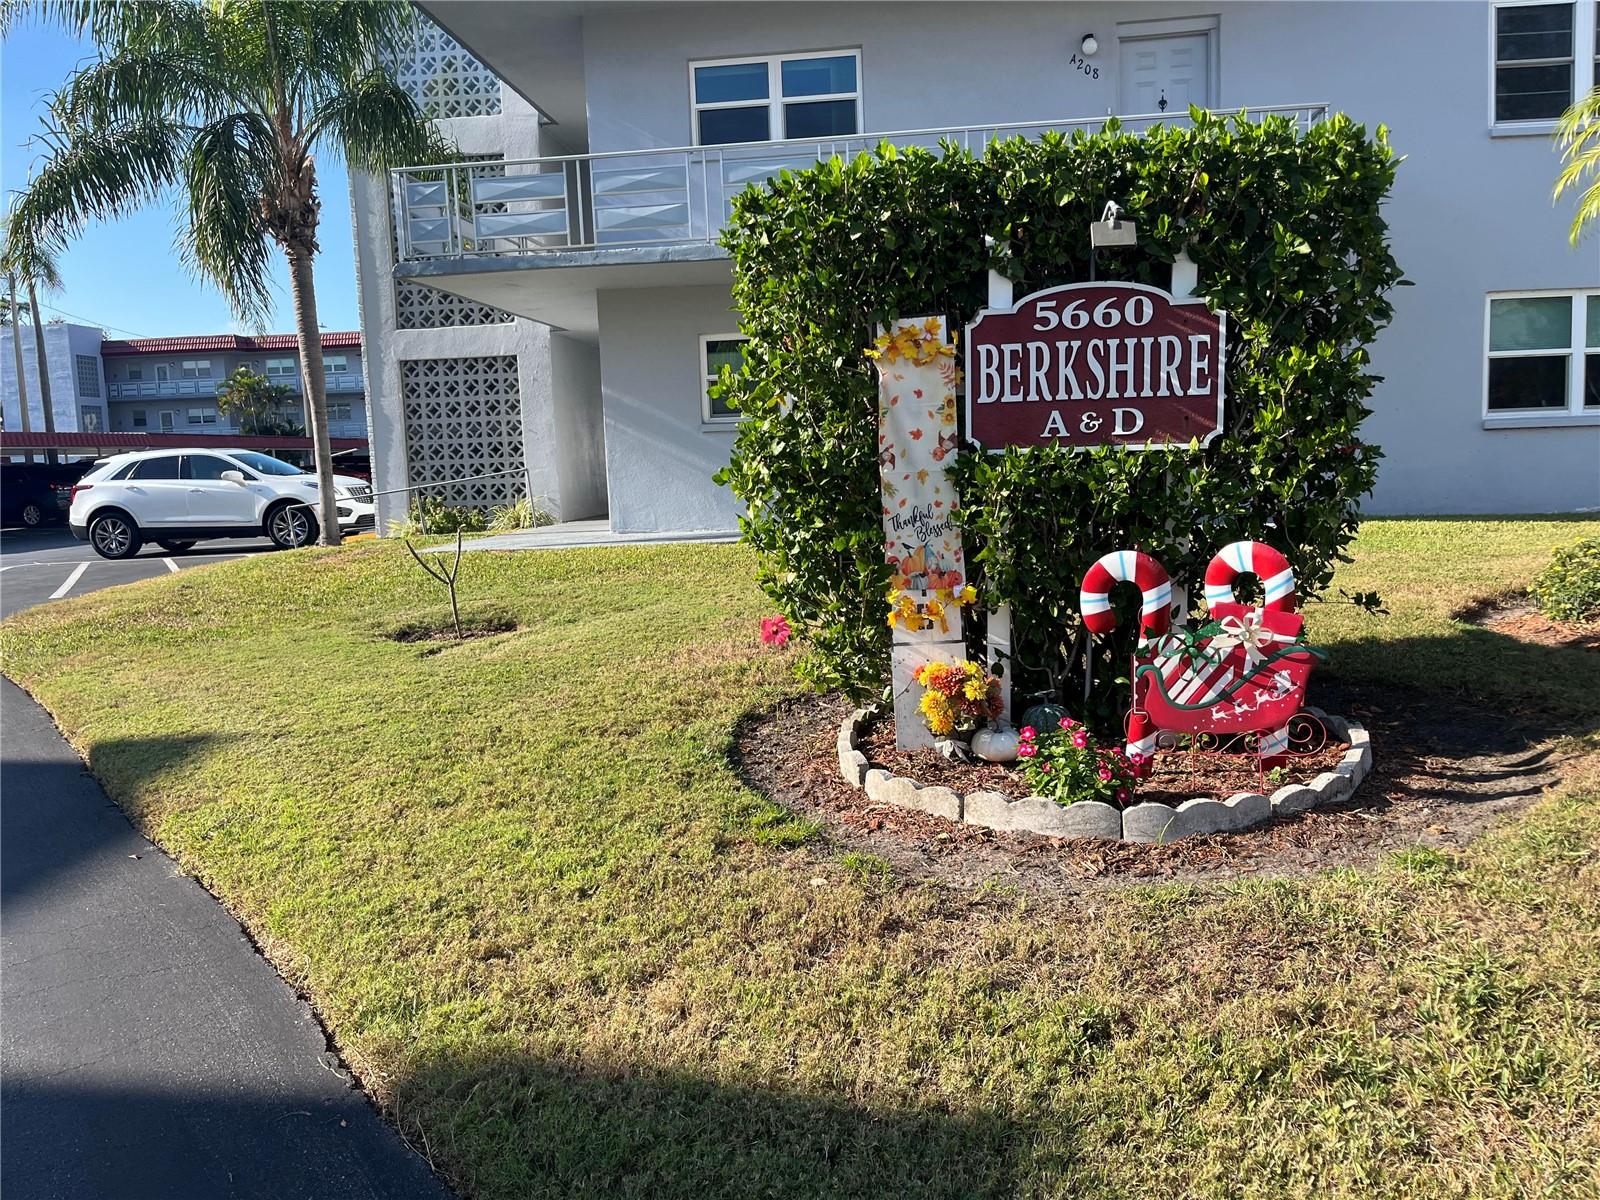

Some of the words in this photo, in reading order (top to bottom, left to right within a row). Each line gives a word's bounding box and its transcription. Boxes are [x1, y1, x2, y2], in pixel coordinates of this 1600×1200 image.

[1069, 53, 1100, 80] A208
[1032, 295, 1154, 332] 5660
[976, 334, 1212, 404] BERKSHIRE
[1040, 410, 1070, 438] A
[1079, 411, 1103, 434] &
[1111, 407, 1145, 436] D
[887, 503, 934, 532] Thankful
[914, 513, 955, 542] Blessed
